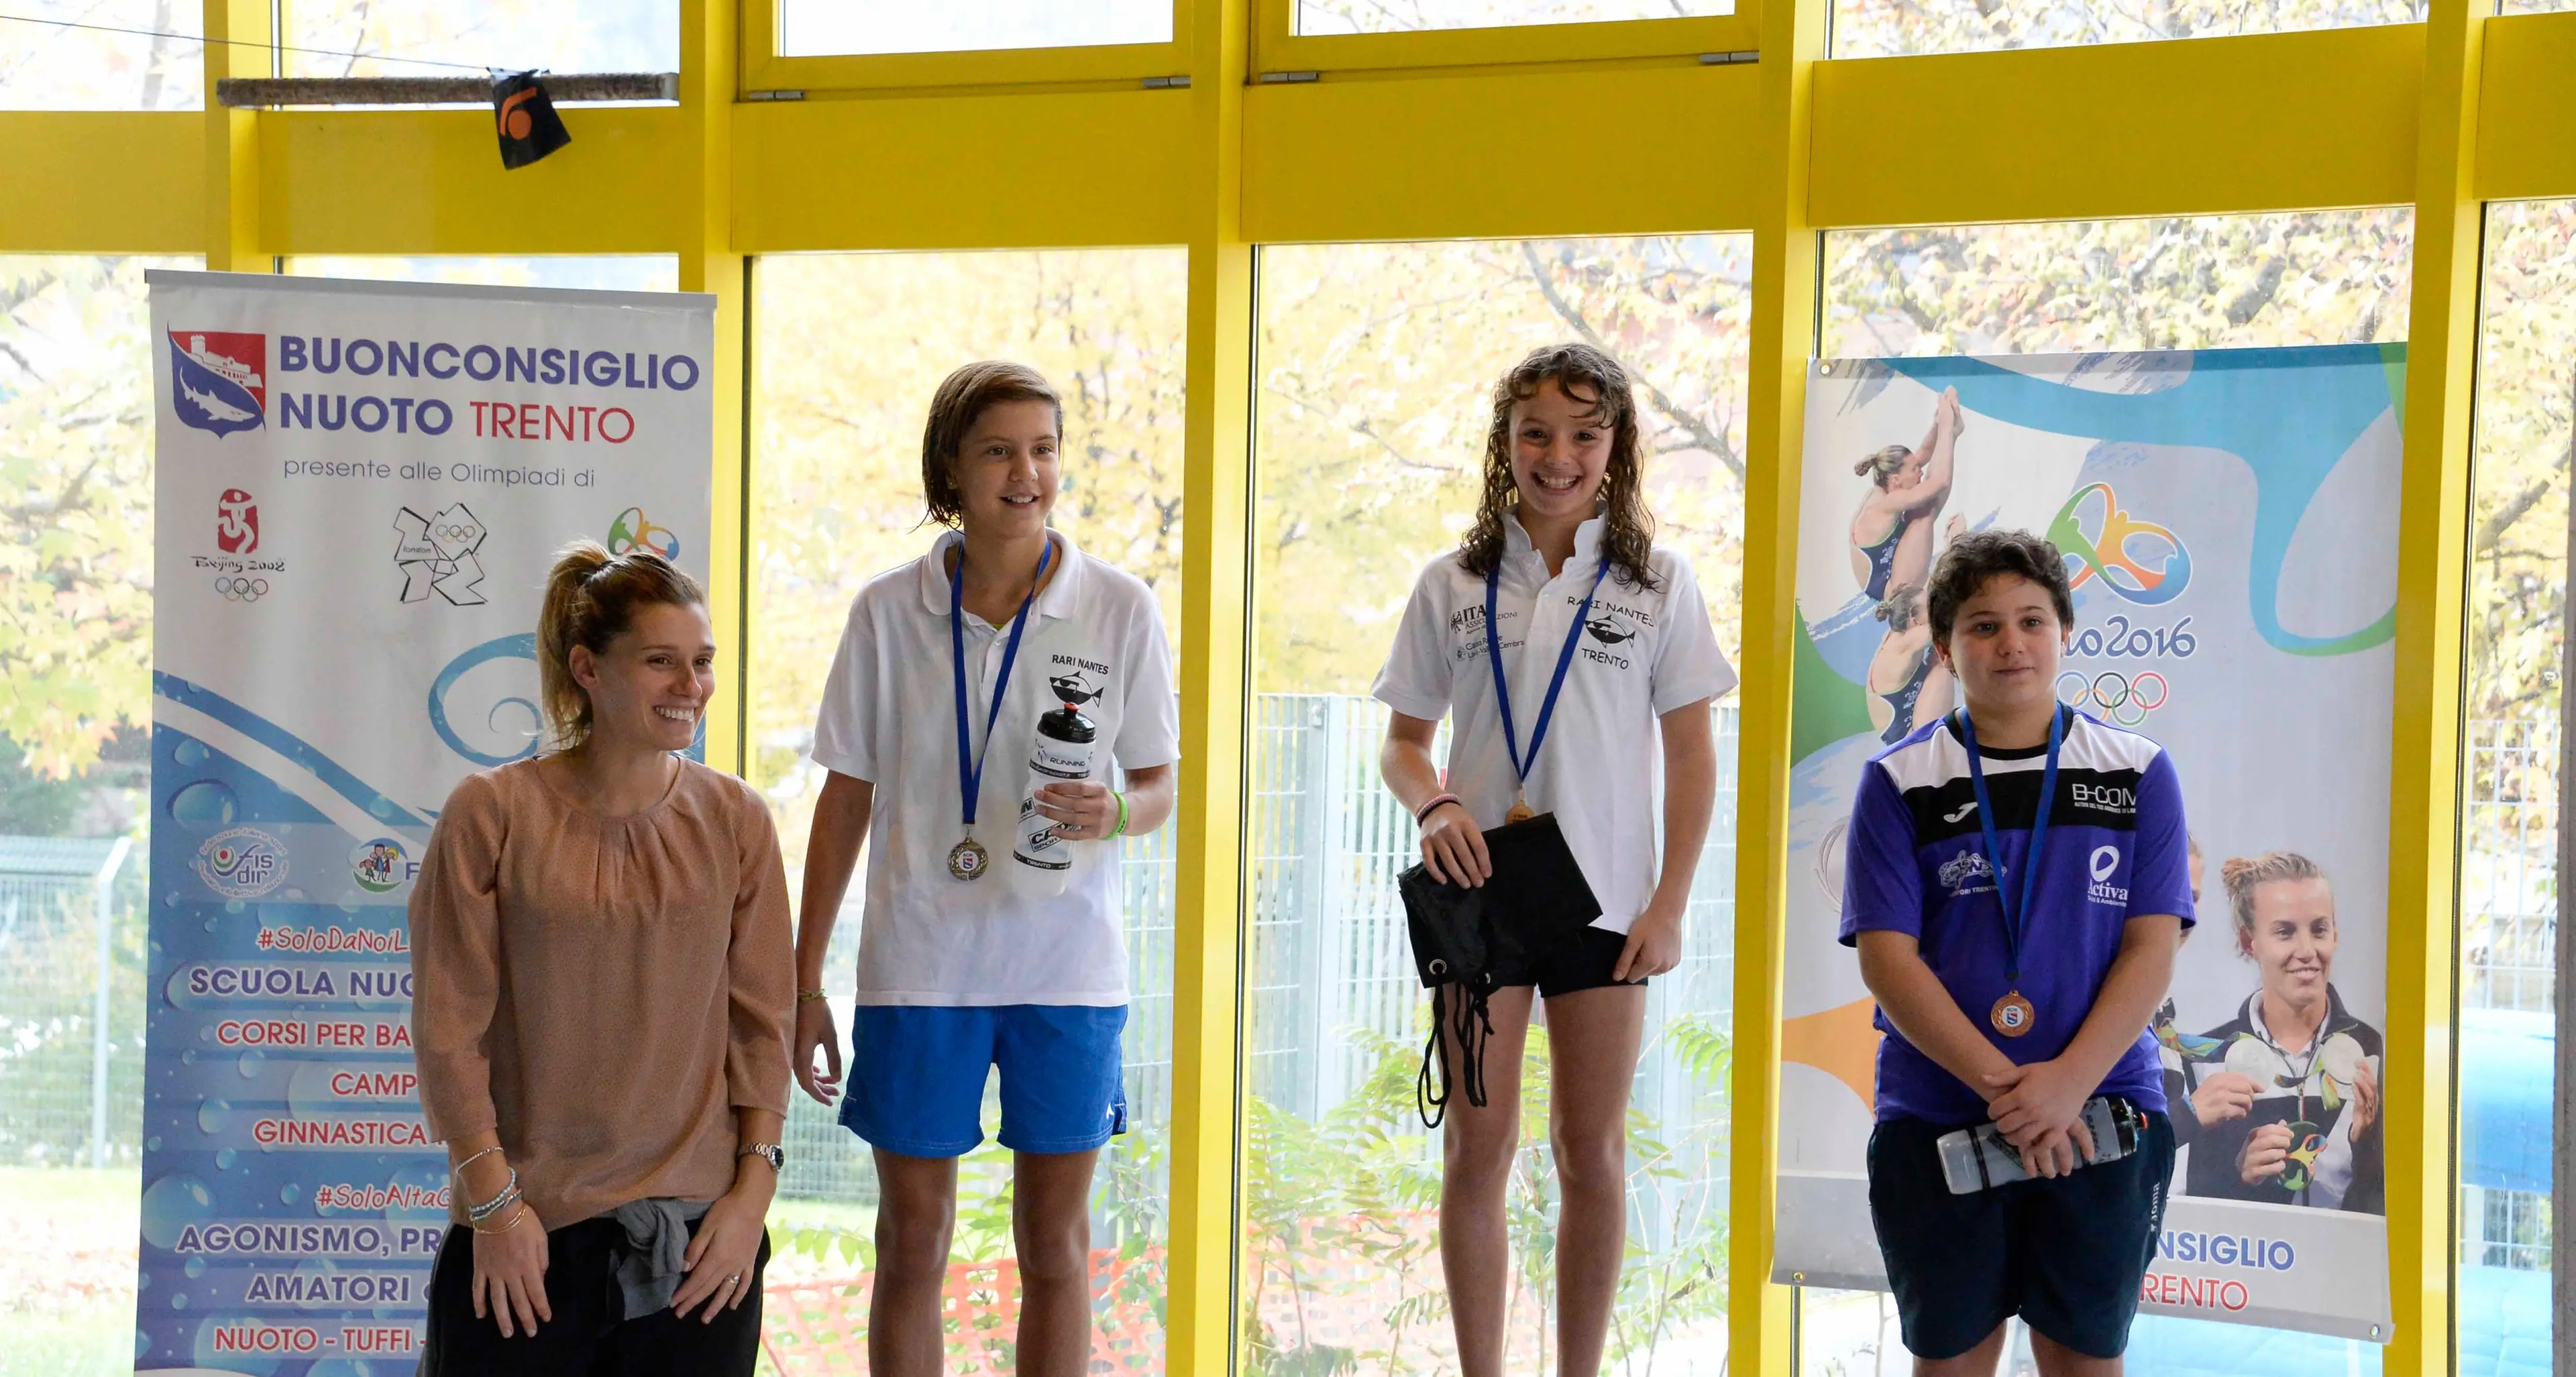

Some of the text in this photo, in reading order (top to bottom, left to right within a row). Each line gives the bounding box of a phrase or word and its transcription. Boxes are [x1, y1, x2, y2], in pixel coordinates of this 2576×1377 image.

[280, 335, 699, 391] BUONCONSIGLIO
[280, 392, 635, 443] NUOTO TRENTO
[284, 459, 594, 487] presente alle Olimpiadi di
[248, 557, 285, 571] 2008
[1567, 596, 1601, 609] RAI
[1052, 654, 1109, 675] RARI NANTES
[1581, 648, 1629, 670] TRENTO
[2088, 878, 2129, 900] Activa
[191, 969, 335, 996] SCUOLA
[217, 1022, 412, 1046] CORSI PER BA
[331, 1073, 417, 1095] CAMP
[254, 1120, 427, 1145] GINNASTICA
[178, 1226, 389, 1256] AGONISMO,
[246, 1276, 409, 1301] AMATORI
[215, 1328, 317, 1351] NUOTO
[343, 1329, 411, 1351] TUFFI
